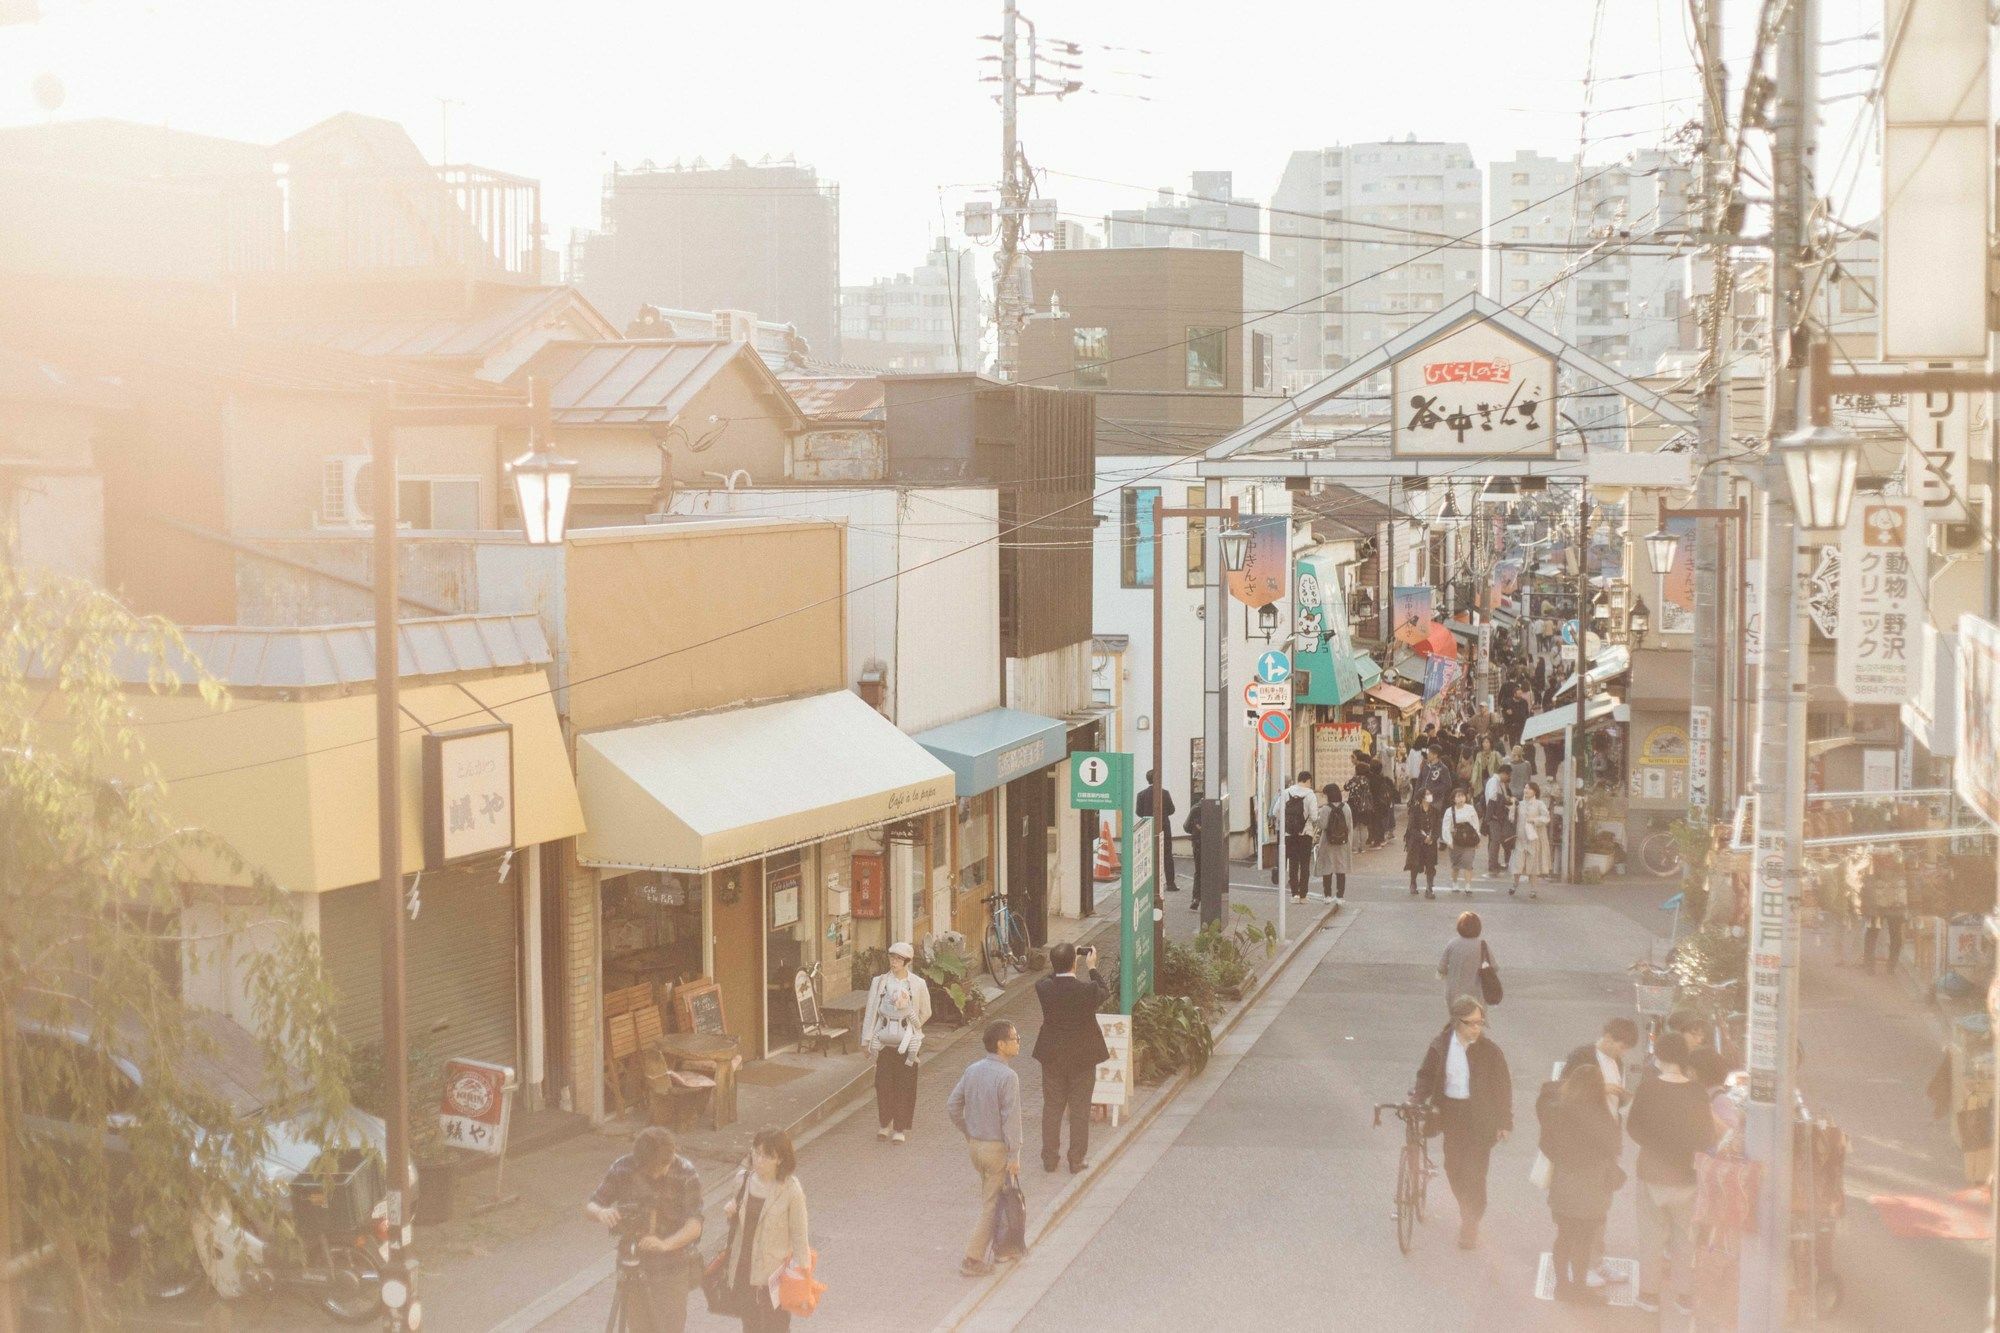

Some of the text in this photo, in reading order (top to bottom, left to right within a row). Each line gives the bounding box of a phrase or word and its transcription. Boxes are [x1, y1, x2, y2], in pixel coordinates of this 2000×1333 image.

[1407, 378, 1542, 443] 谷中ぎんざ
[1426, 357, 1509, 383] ひぐらしの里
[1858, 552, 1881, 658] クリニック
[1882, 551, 1909, 660] 動物・野沢
